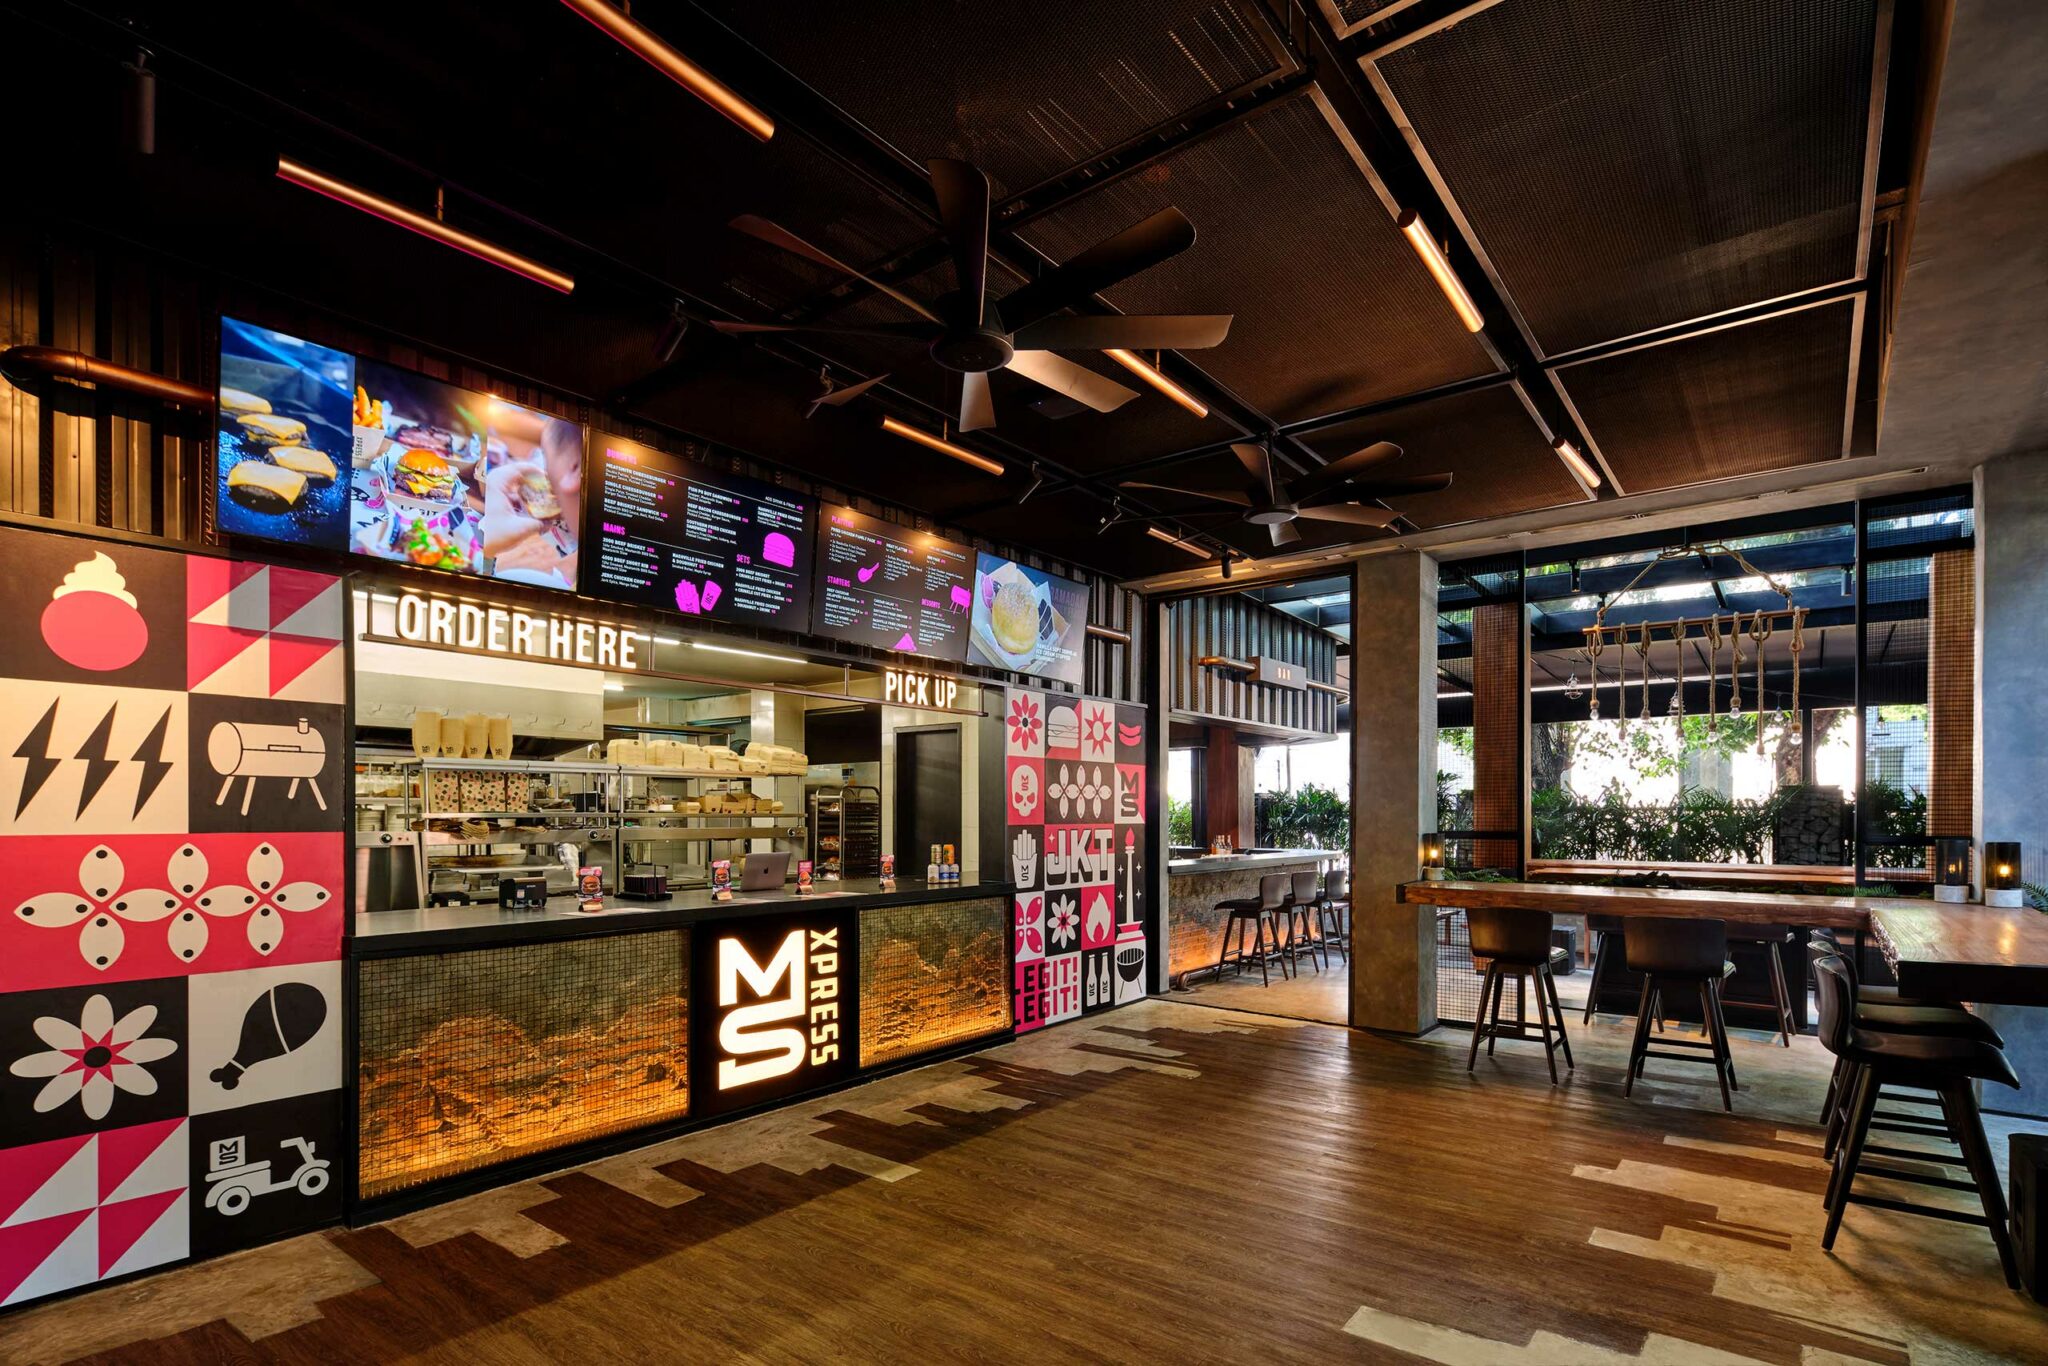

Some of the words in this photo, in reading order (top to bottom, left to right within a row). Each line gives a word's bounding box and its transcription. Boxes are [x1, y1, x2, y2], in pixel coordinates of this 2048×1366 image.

[632, 470, 666, 483] CHEESEBURGER
[605, 480, 621, 489] SINGLE
[622, 484, 656, 498] CHEESEBURGER
[712, 493, 732, 502] SANDWICH
[616, 501, 635, 510] BRISKET
[636, 506, 659, 516] SANDWICH
[712, 509, 740, 520] CHEESEBURGER
[603, 522, 625, 535] MAINS
[686, 519, 706, 528] SOUTHERN
[720, 527, 736, 535] CHICKEN
[686, 523, 706, 532] SANDWICH
[626, 542, 645, 550] BRISKET
[672, 553, 694, 561] NASHVILLE
[676, 559, 697, 567] DOUGHNUT
[736, 553, 750, 564] SETS
[827, 575, 850, 587] STARTERS
[921, 598, 940, 608] DESSERTS
[397, 593, 534, 656] ORDER
[549, 617, 638, 669] HERE
[1277, 667, 1291, 681] BAR
[885, 671, 929, 706] PICK
[935, 679, 957, 709] UP
[1020, 774, 1029, 791] MS
[1120, 771, 1139, 817] MS
[1046, 828, 1113, 885] JKT
[1021, 864, 1030, 882] MS
[718, 929, 807, 1091] MS
[810, 926, 839, 1067] XPRESS
[218, 1140, 239, 1166] MS
